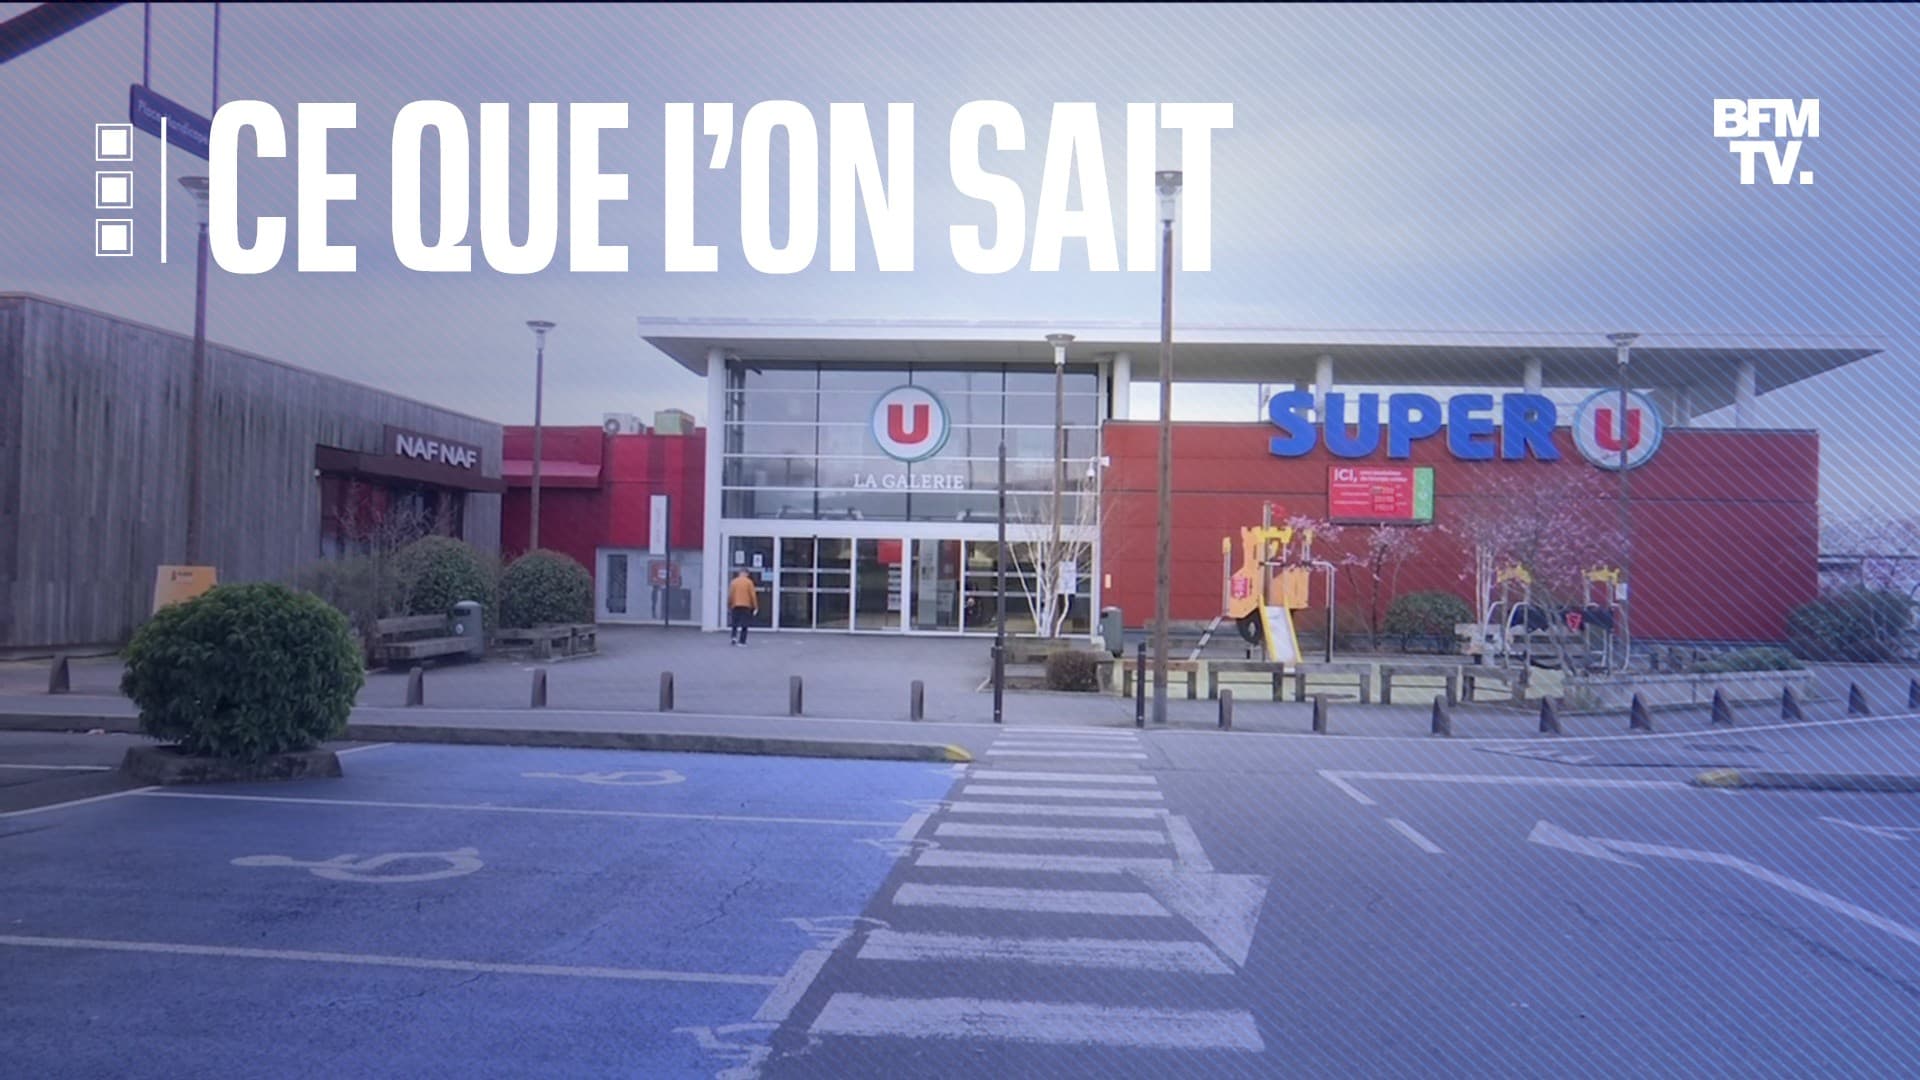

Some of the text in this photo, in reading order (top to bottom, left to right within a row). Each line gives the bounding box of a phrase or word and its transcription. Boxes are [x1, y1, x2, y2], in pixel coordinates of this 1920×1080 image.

[887, 403, 930, 445] U
[1268, 391, 1642, 460] SUPER U
[396, 433, 478, 469] NAF NAF
[854, 473, 965, 489] LA GALERIE
